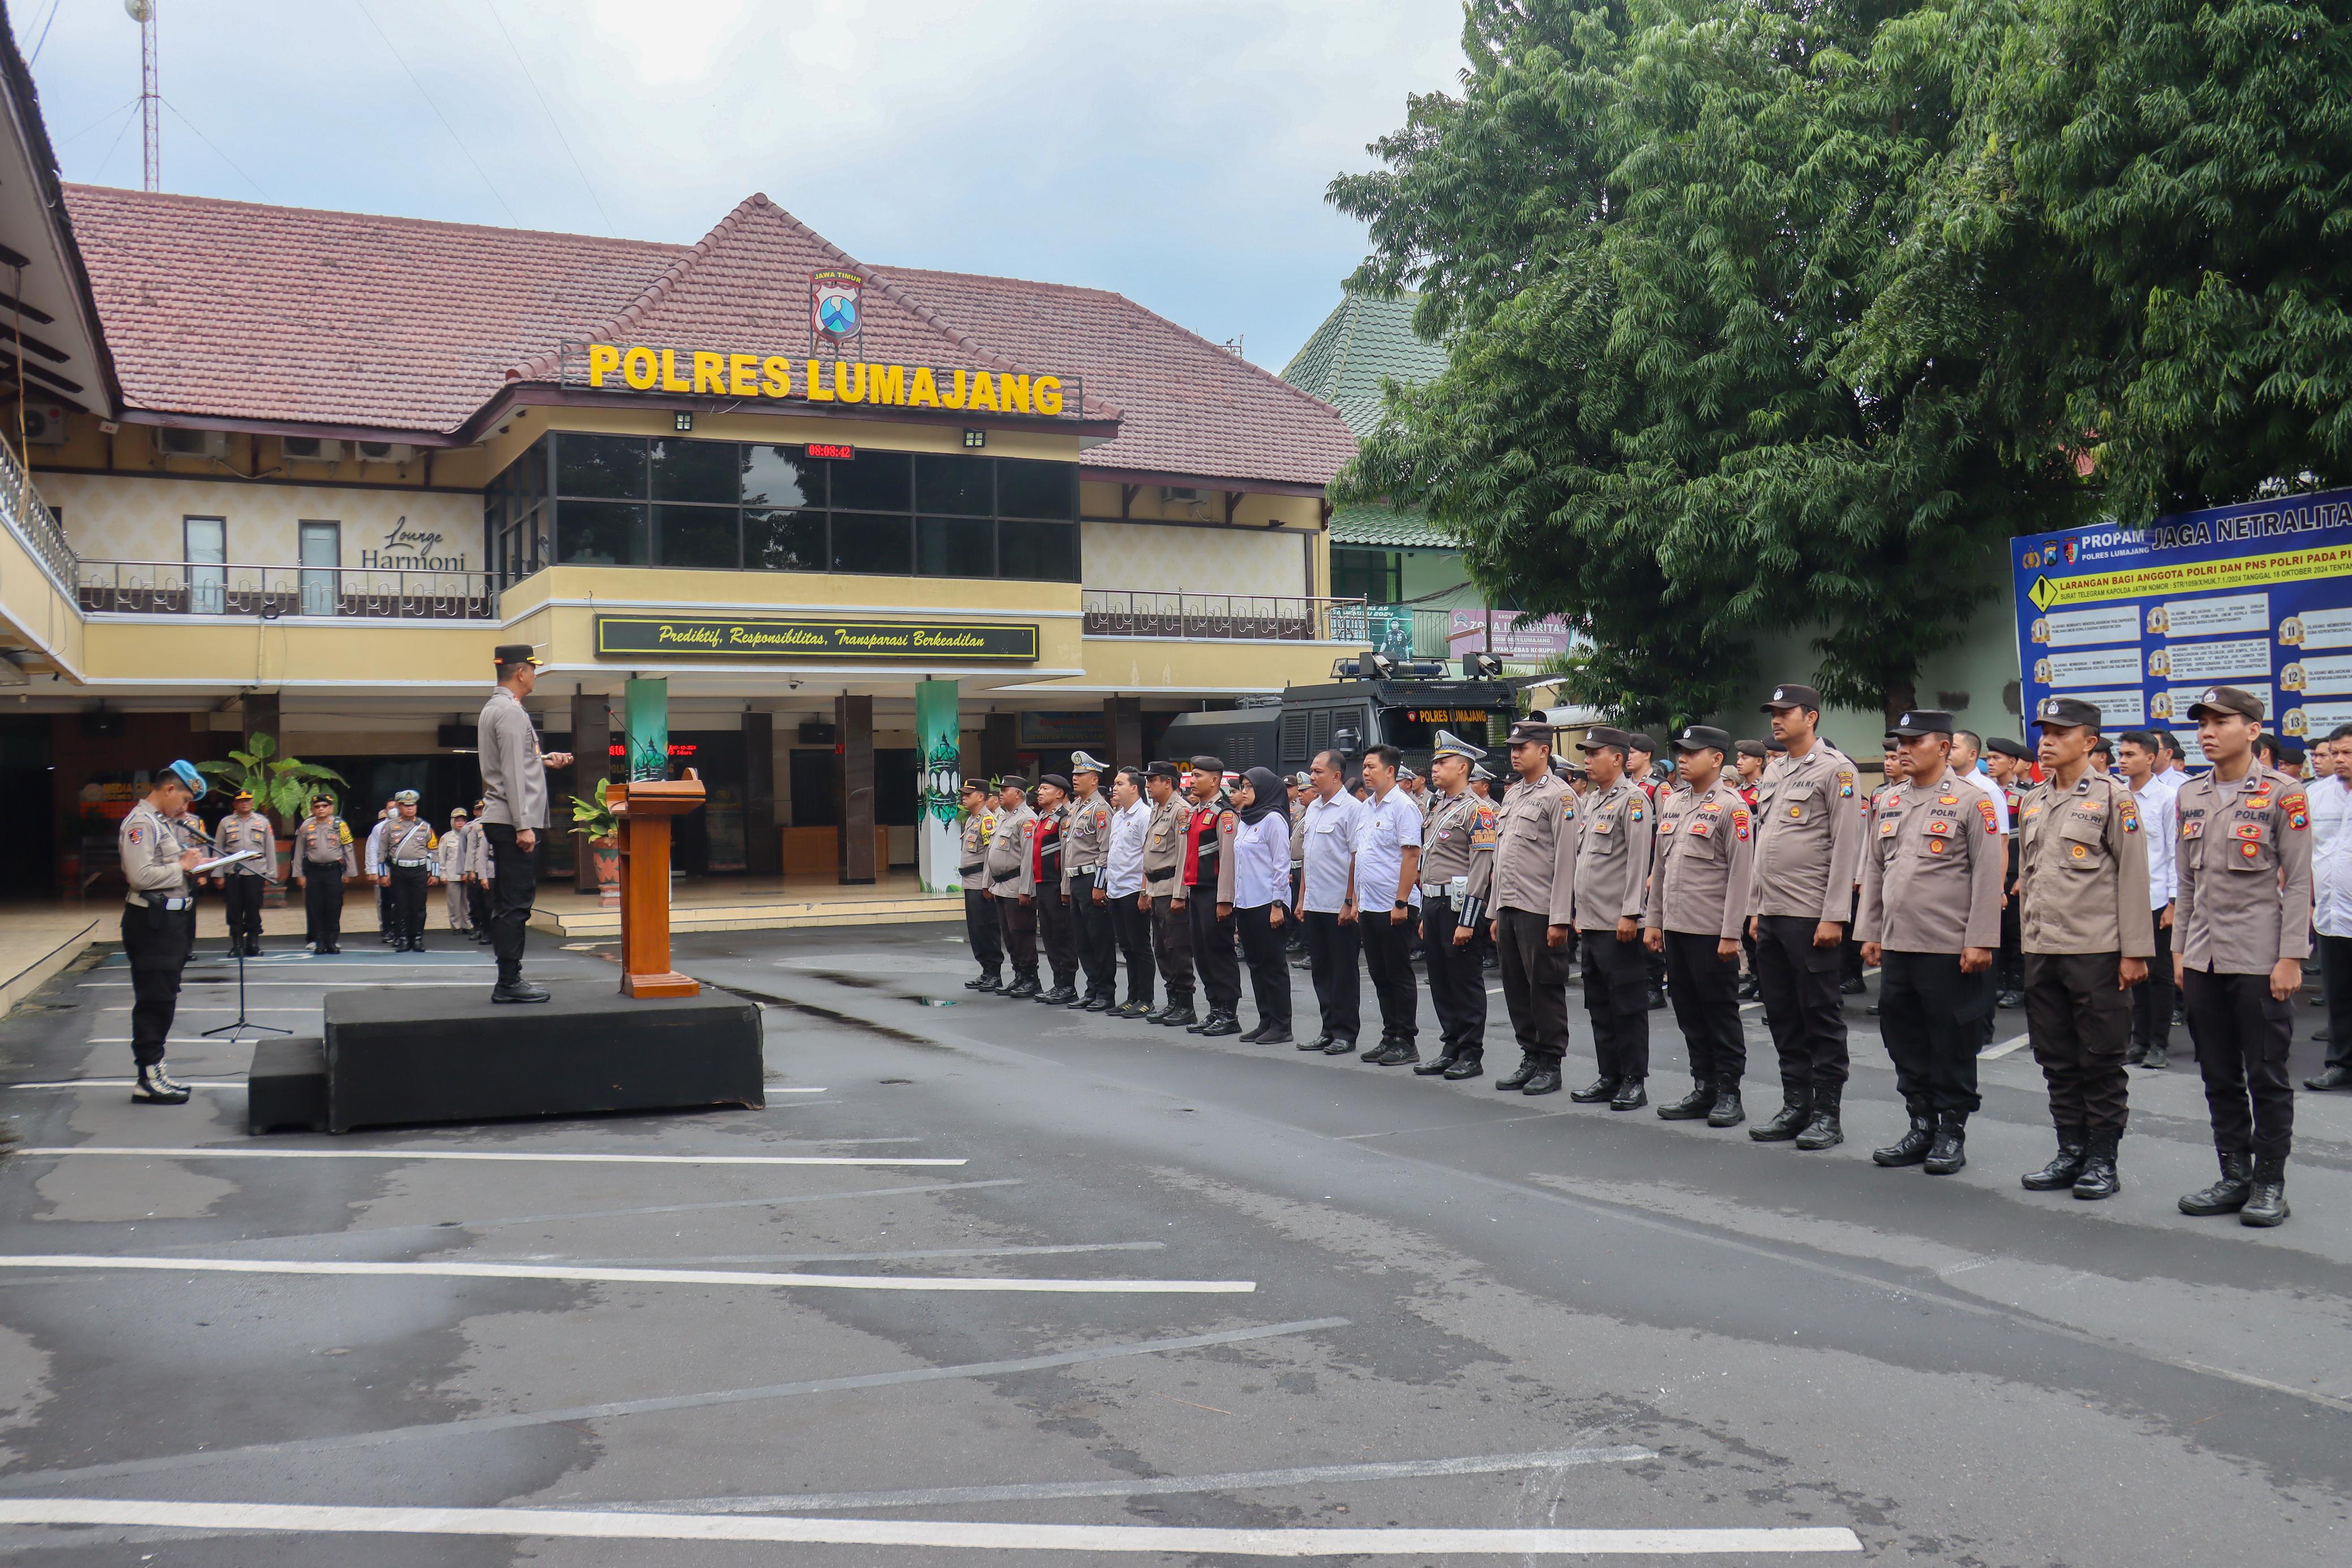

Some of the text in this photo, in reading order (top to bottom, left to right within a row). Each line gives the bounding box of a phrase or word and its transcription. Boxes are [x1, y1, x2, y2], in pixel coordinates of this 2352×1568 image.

[837, 272, 862, 284] TIMUR
[590, 344, 1063, 416] POLRES LUMAJANG
[808, 444, 851, 458] 08:08:42
[384, 516, 443, 556] Lounge
[2082, 529, 2145, 549] PROPAM
[2152, 522, 2211, 551] JAGA
[362, 549, 465, 571] Harmoni
[2082, 547, 2150, 561] POLRES LUMAJANG
[2060, 578, 2109, 590] LARANGAN
[2112, 575, 2134, 585] BAGI
[2137, 570, 2184, 582] ANGGOTA
[2187, 566, 2216, 577] POLRI
[2220, 563, 2241, 573] DAN
[2245, 560, 2266, 570] PNS
[2270, 556, 2303, 567] POLRI
[2307, 552, 2336, 563] PADA
[2148, 583, 2169, 591] NOMOR
[2243, 572, 2271, 581] TANGGAL
[2281, 568, 2312, 577] OKTOBER
[2155, 615, 2160, 625] 6
[2039, 626, 2042, 635] 1
[2287, 626, 2295, 636] 11
[659, 625, 985, 649] Prediktif, Responsibilitas, Transparasi Berkeadilan
[2158, 658, 2162, 668] 7
[2040, 666, 2045, 675] 2
[2288, 672, 2298, 682] 12
[2159, 700, 2164, 711] 8
[1419, 710, 1448, 722] POLRES
[2290, 717, 2299, 727] 13
[1525, 799, 1543, 808] POLRI
[1696, 813, 1719, 822] POLRI
[1930, 809, 1956, 818] POLRI
[2070, 812, 2102, 824] POLRI
[2235, 809, 2270, 821] POLRI
